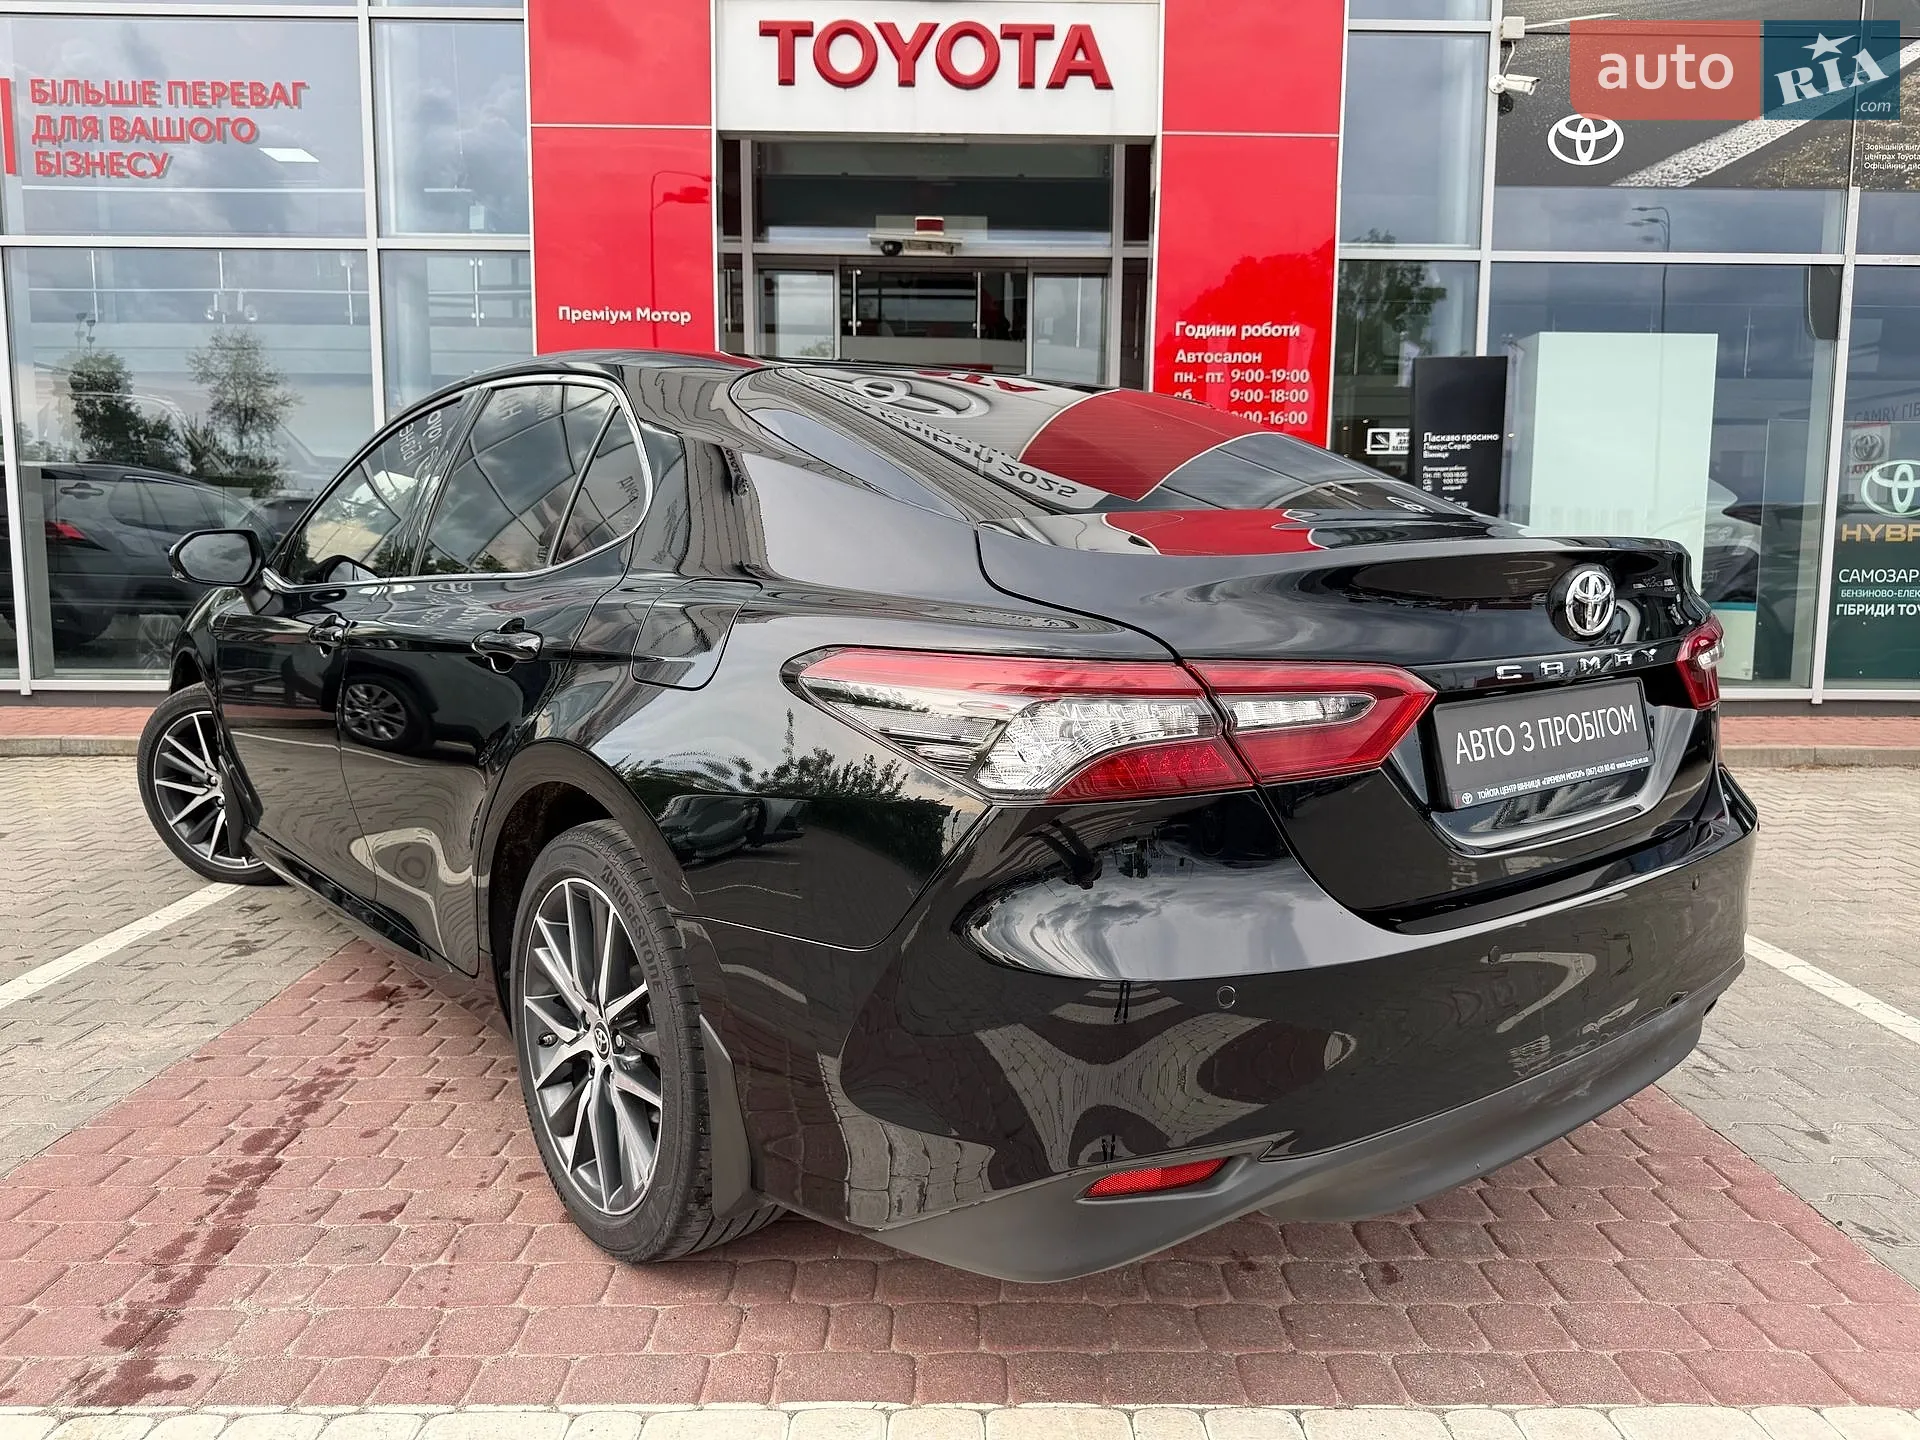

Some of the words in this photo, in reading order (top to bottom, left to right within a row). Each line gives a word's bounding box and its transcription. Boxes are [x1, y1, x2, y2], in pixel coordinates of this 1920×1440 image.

[759, 19, 1114, 90] TOYOTA
[30, 79, 157, 106] БІЛЬШЕ
[167, 81, 306, 107] ПЕРЕВАГ
[32, 115, 100, 144] ДЛЯ
[109, 116, 257, 143] ВАШОГО
[35, 151, 168, 177] БІЗНЕСУ
[558, 306, 632, 325] Преміум
[636, 307, 691, 326] Мотор
[1175, 321, 1236, 338] Години
[1241, 322, 1300, 340] роботи
[1175, 349, 1262, 364] Автосалон
[1231, 369, 1310, 383] 9:00-19:00
[1230, 389, 1309, 403] 9:00-18:00
[1836, 603, 1895, 617] ГІБРИДИ
[1496, 648, 1656, 680] CAMRY
[1456, 724, 1515, 764] АВТО
[1538, 704, 1637, 749] ПРОБІГОМ
[600, 865, 663, 992] BRIDGESTONE
